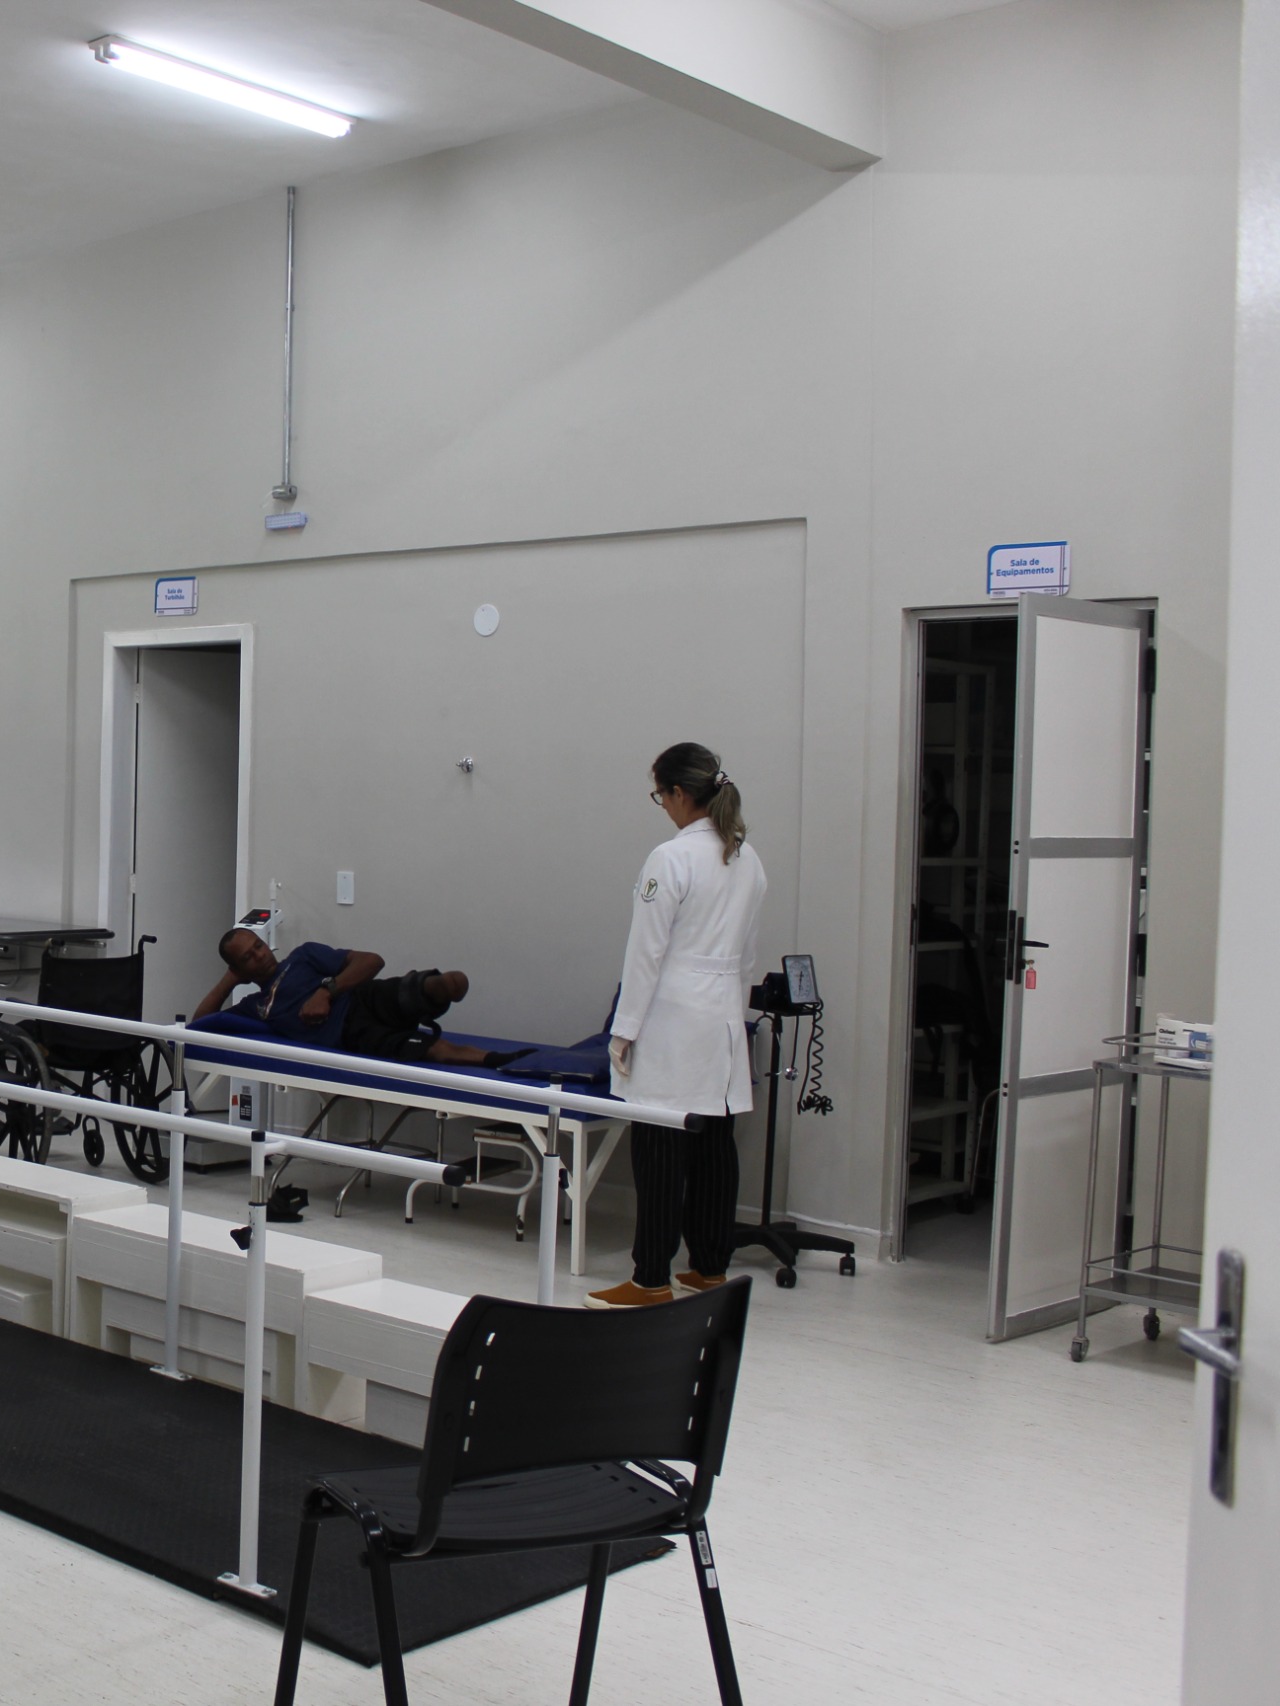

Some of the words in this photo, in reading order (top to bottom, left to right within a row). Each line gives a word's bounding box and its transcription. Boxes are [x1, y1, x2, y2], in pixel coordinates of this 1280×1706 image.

[1010, 559, 1027, 567] Sala
[1029, 558, 1040, 566] de
[996, 567, 1054, 577] Equipamentos
